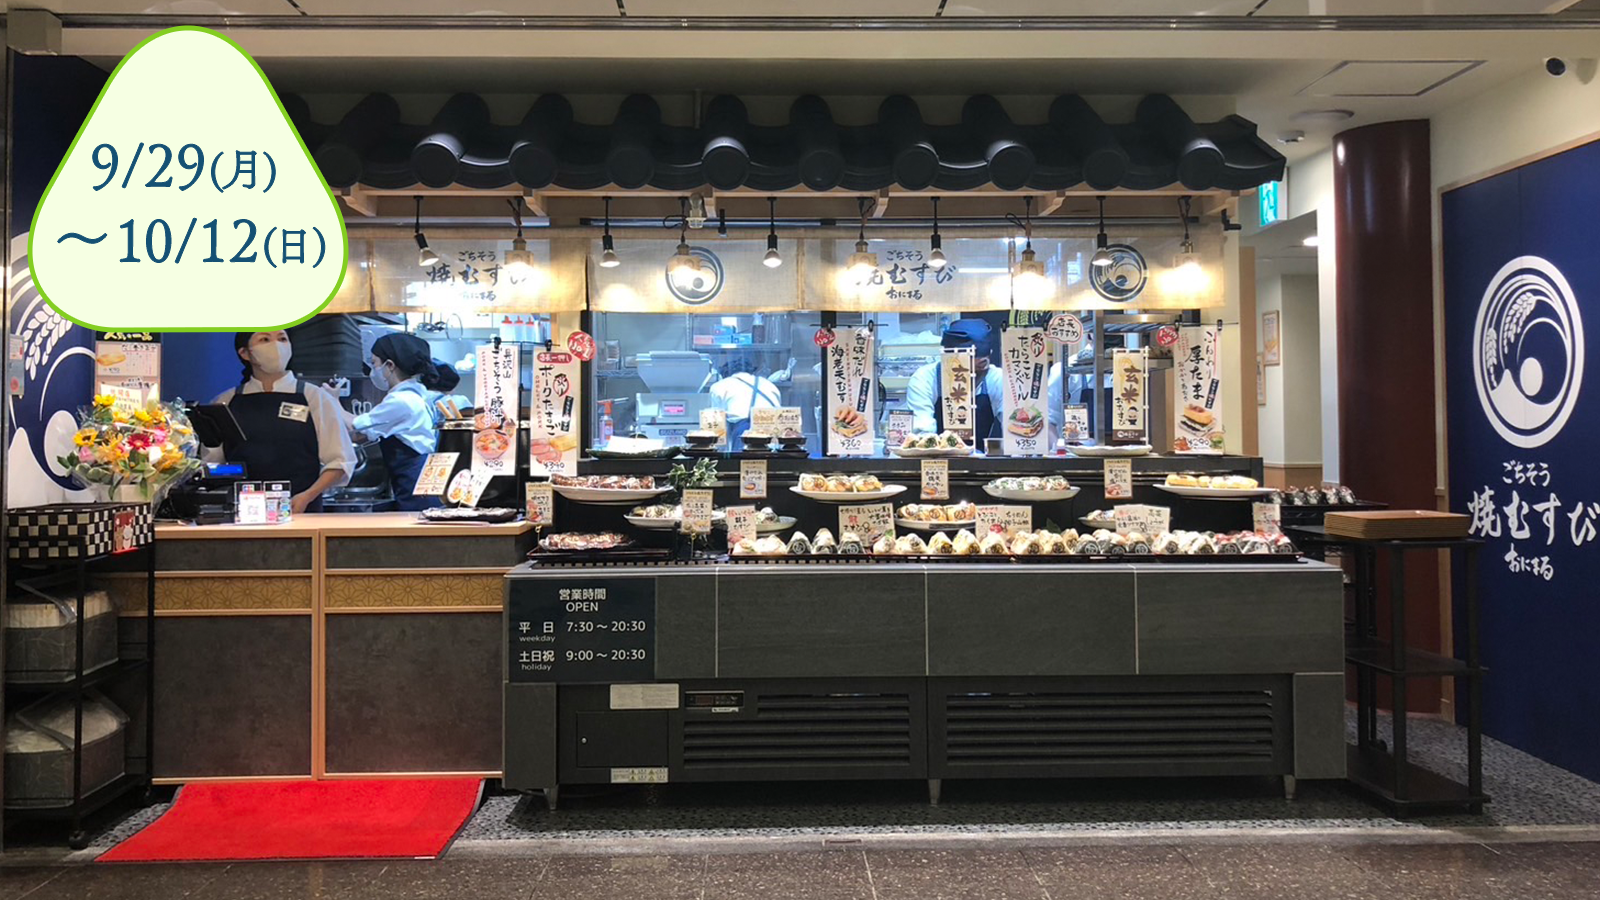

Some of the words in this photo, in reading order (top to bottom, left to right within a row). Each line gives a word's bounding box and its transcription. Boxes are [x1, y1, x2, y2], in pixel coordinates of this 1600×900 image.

[458, 251, 497, 262] ごちそう
[886, 250, 924, 262] ごちそう
[830, 345, 848, 404] 海老天むす
[1009, 347, 1029, 402] カマンベール
[1018, 336, 1031, 381] たらこと
[1185, 345, 1205, 401] 厚たま
[1204, 331, 1216, 380] ふんわり
[539, 364, 561, 436] ポークたまご
[950, 364, 970, 404] 玄米
[1121, 365, 1142, 404] 玄米
[1015, 438, 1037, 449] ¥350
[1502, 459, 1551, 487] ごちそう
[1467, 485, 1600, 546] 焼むすび
[1504, 542, 1554, 581] おにまる
[559, 588, 607, 600] 営業時間
[565, 602, 599, 612] OPEN
[519, 634, 556, 643] weekday
[519, 650, 555, 663] 土日祝
[521, 663, 552, 671] holiday
